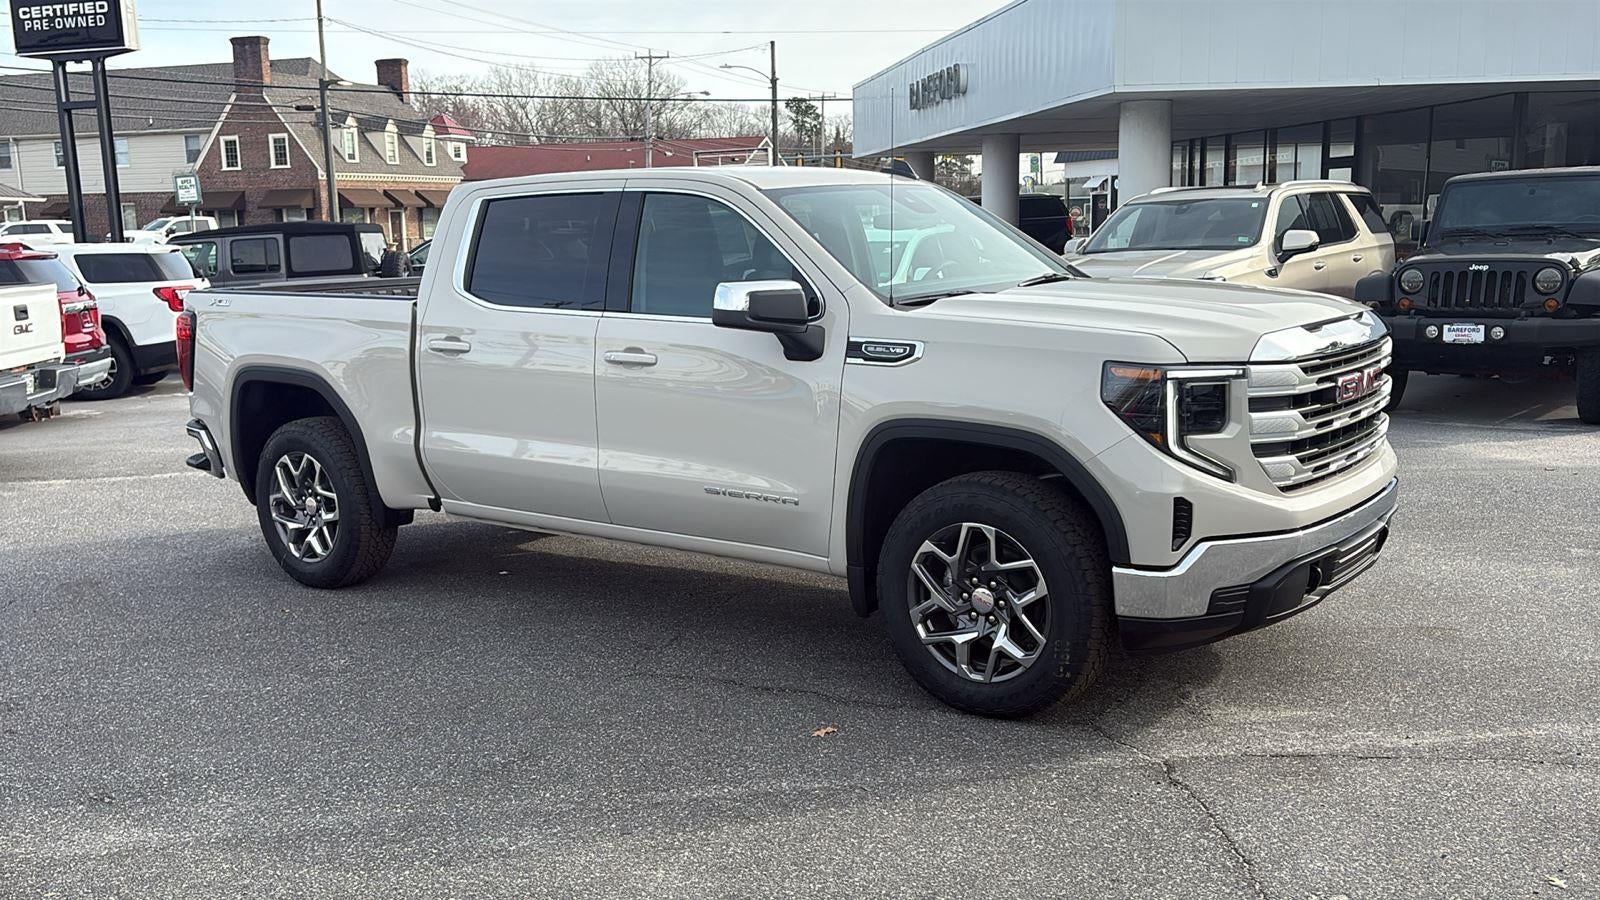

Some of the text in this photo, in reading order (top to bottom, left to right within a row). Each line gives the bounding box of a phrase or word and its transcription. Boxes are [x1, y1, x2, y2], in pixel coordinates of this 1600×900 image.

[19, 1, 108, 19] CERTIFIED
[24, 15, 105, 31] PRE-OWNED
[14, 323, 33, 335] GMC
[1338, 367, 1382, 402] GMC
[703, 485, 799, 506] SIERRA
